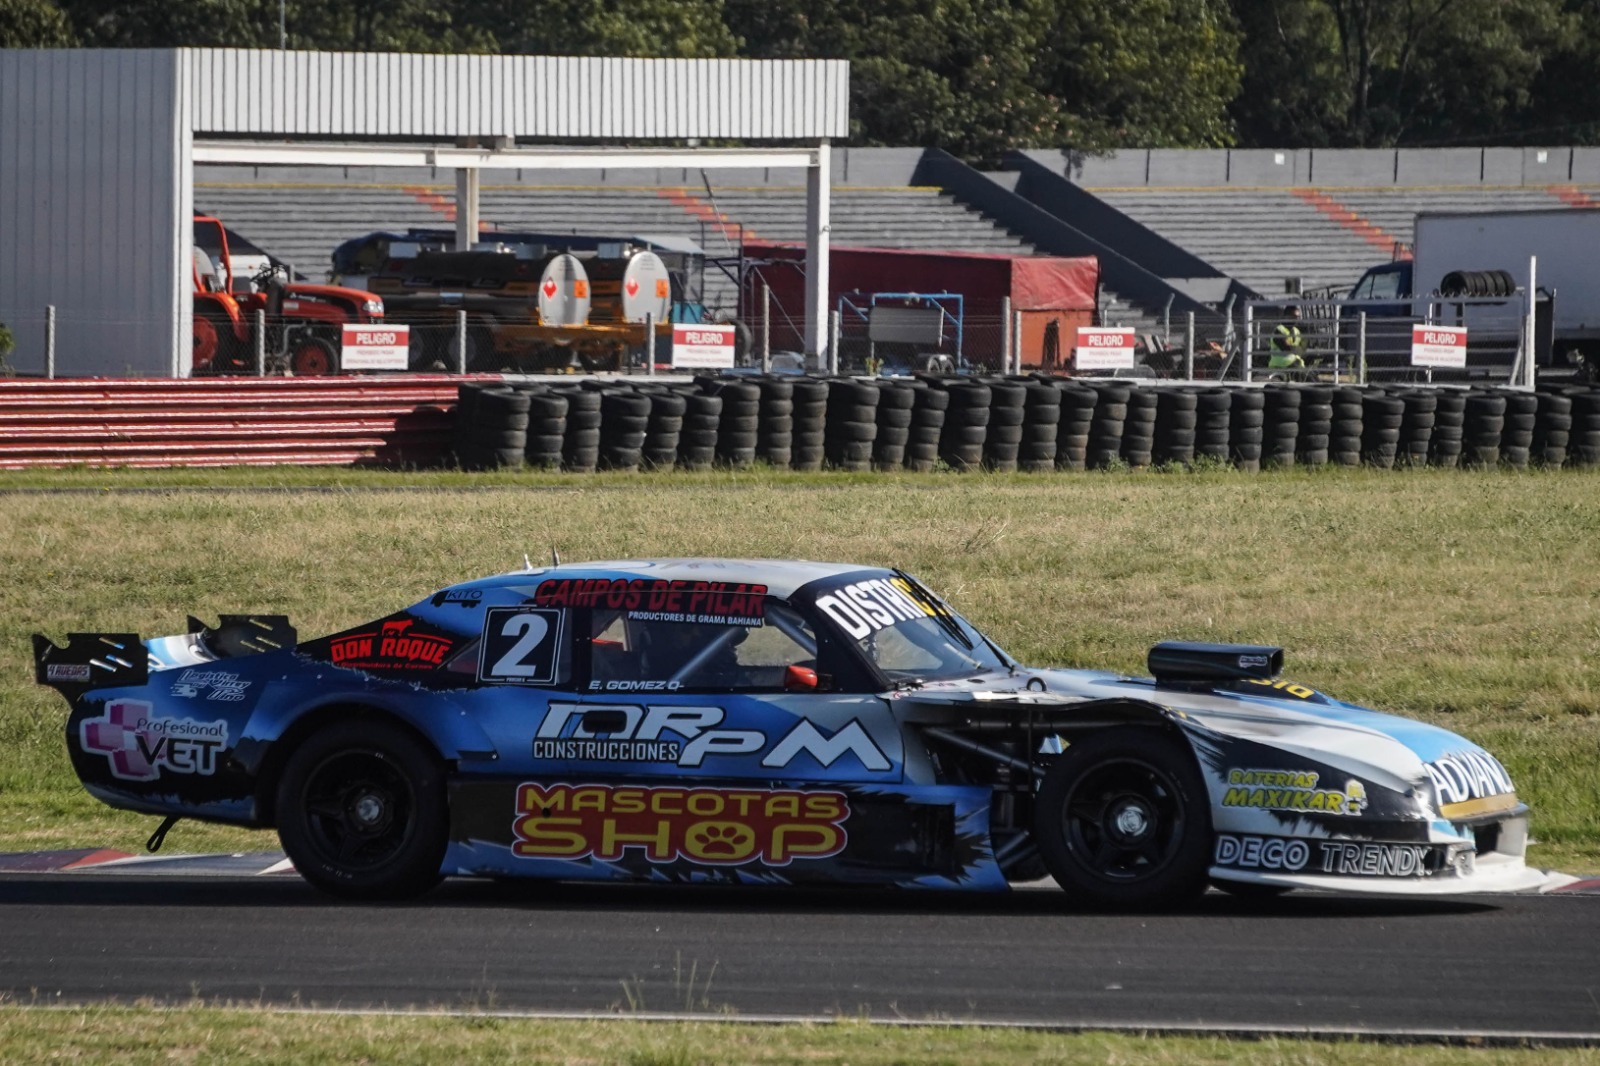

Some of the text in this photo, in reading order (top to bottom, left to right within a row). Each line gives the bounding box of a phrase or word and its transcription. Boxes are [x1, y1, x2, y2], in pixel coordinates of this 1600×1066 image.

[356, 332, 396, 345] PELIGRO
[685, 331, 723, 345] PELIGRO
[1088, 334, 1123, 346] PELIGRO
[1424, 332, 1456, 345] PELIGRO
[446, 589, 483, 600] KITO
[534, 578, 768, 616] CAMPOS DE PILAR
[628, 610, 762, 626] PRODUCTORES DE GRAMA BAHIANA
[330, 637, 450, 665] DON ROQUE
[490, 613, 549, 677] 2
[588, 680, 603, 690] E.
[606, 680, 667, 690] GOMEZ
[136, 717, 225, 738] Profesional
[135, 734, 222, 771] VET
[533, 740, 679, 761] CONSTRUCCIONES
[1228, 769, 1318, 789] BATERIAS
[524, 788, 841, 818] MASCOTAS
[1222, 788, 1346, 813] MAXIKAR
[520, 815, 838, 861] SHOP
[1216, 835, 1310, 870] DECO
